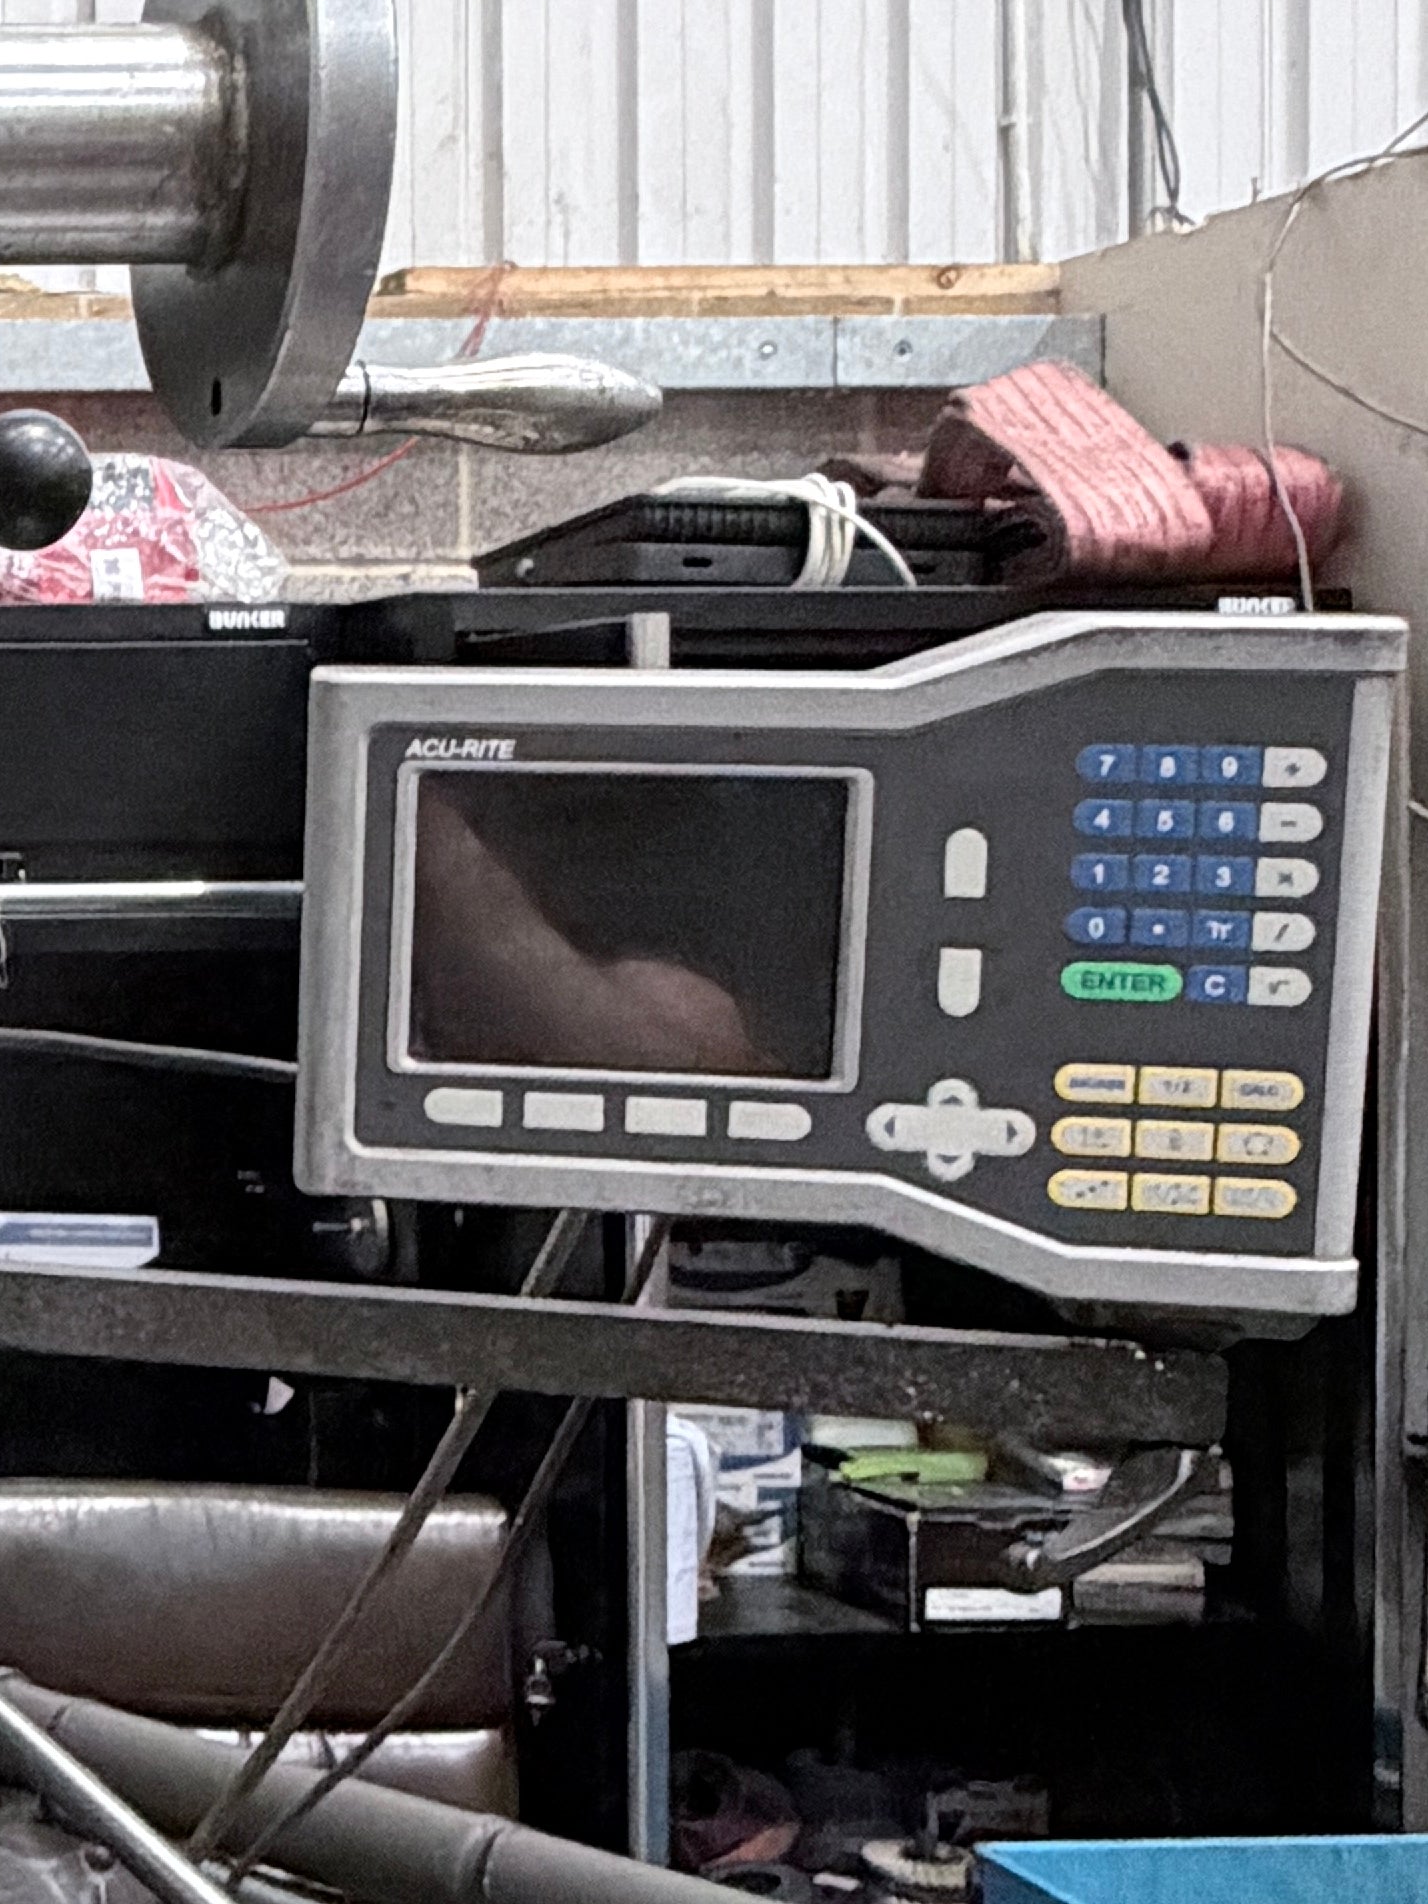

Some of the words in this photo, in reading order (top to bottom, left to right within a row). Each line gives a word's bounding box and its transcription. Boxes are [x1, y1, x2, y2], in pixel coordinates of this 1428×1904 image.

[404, 738, 516, 760] ACU-RITE
[1099, 754, 1117, 777] 7
[1158, 755, 1176, 778] 8
[1220, 756, 1239, 779] 9
[1093, 807, 1111, 830] 4
[1156, 809, 1175, 832] 5
[1217, 810, 1235, 833] 6
[1092, 862, 1106, 884] 1
[1152, 864, 1170, 886] 2
[1214, 866, 1232, 887] 3
[1087, 915, 1106, 939] 0
[1080, 969, 1166, 993] ENTER
[1203, 974, 1226, 996] C
